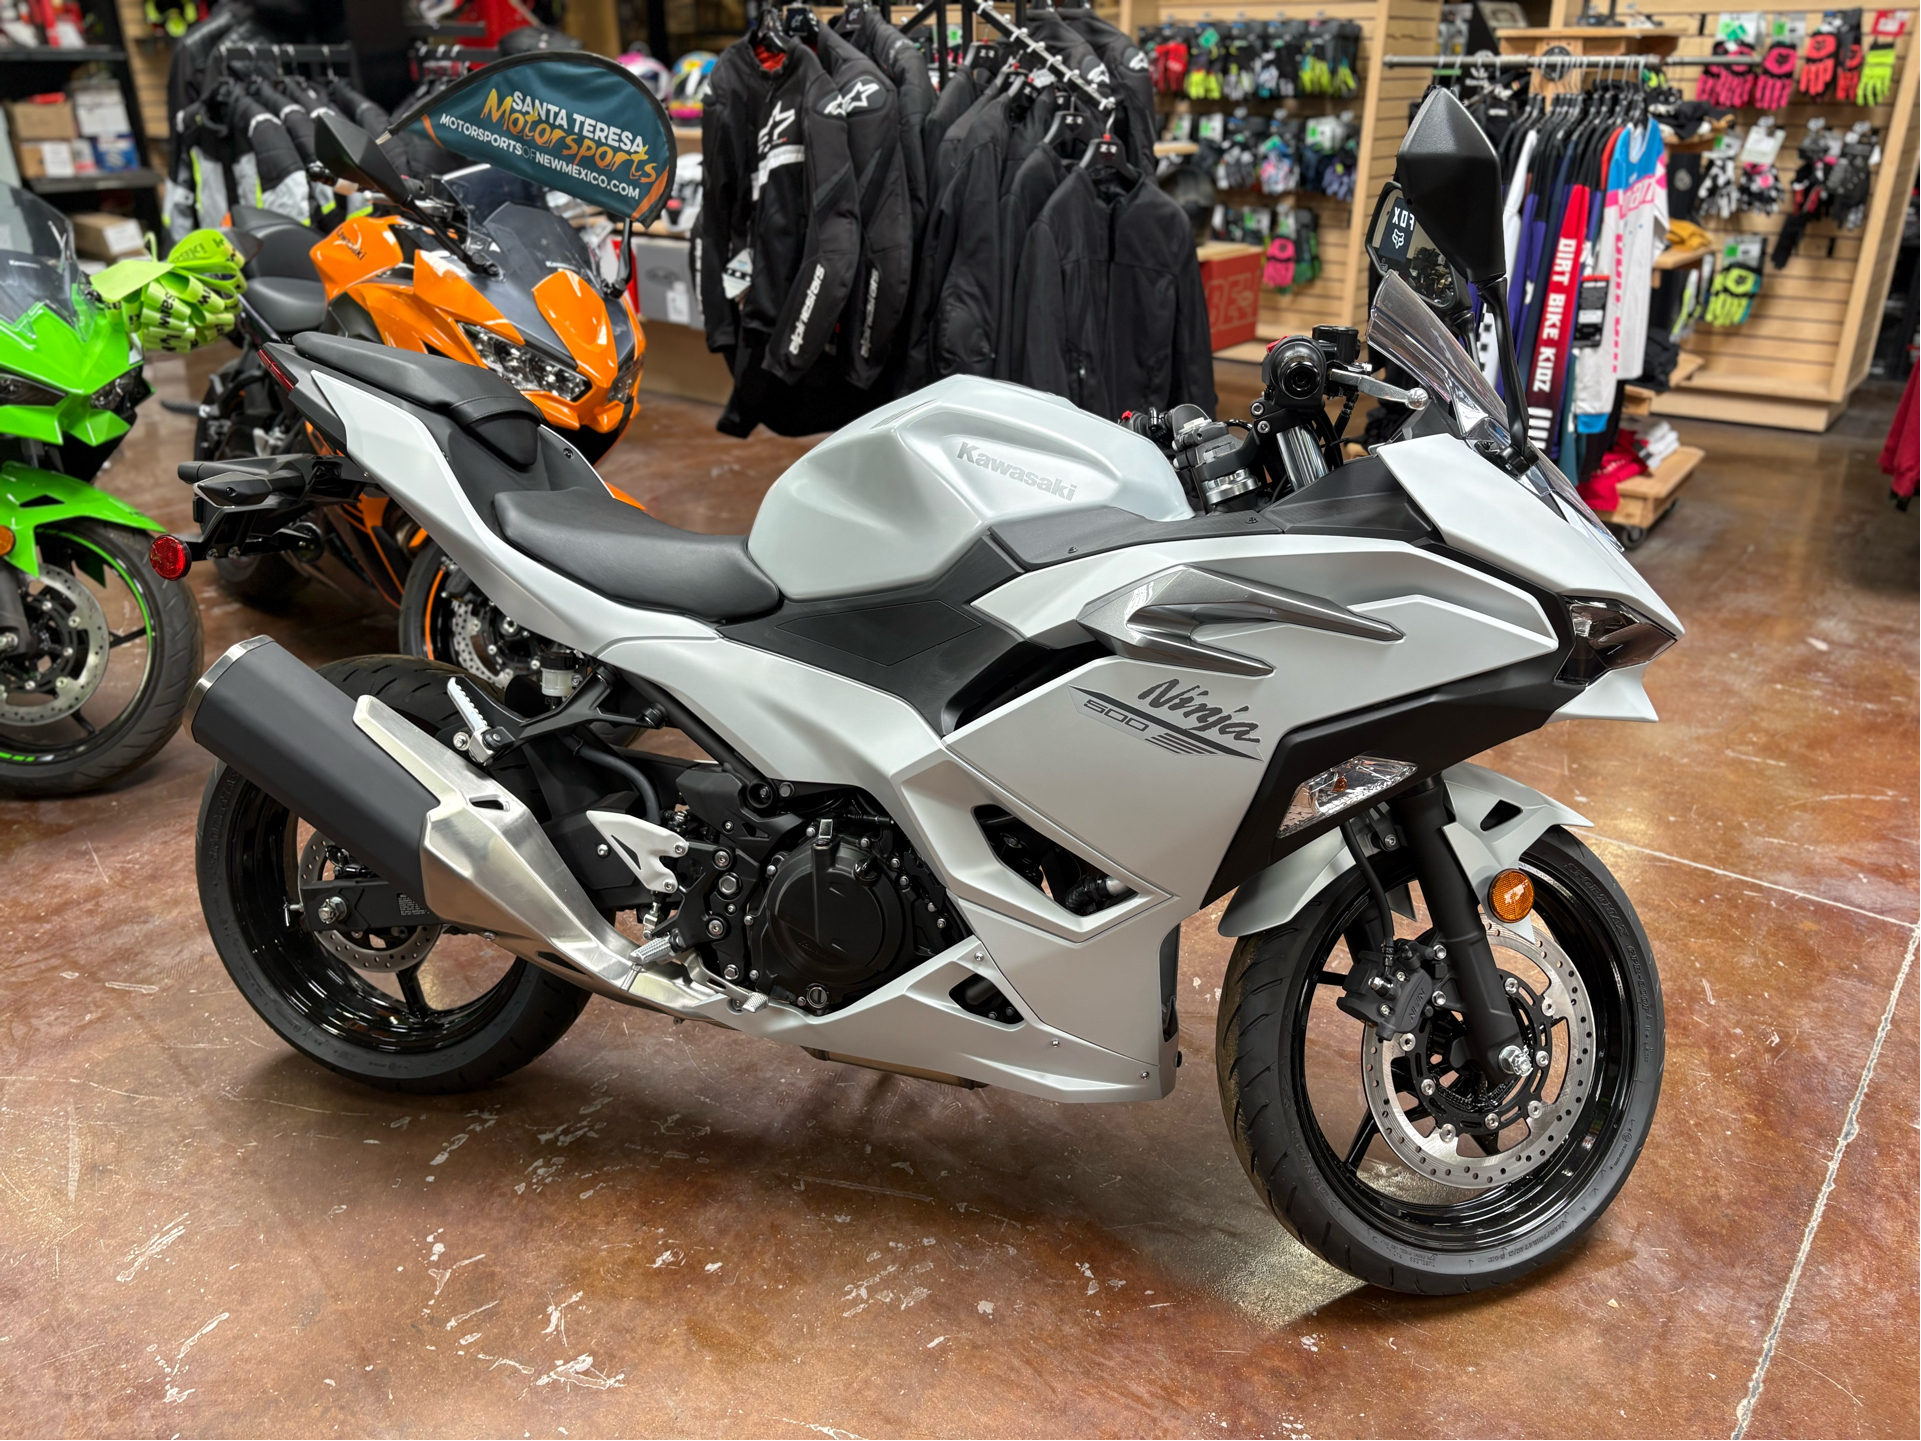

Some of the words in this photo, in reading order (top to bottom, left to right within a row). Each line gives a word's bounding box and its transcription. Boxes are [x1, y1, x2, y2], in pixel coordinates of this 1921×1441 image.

[480, 87, 658, 183] Motorsports
[512, 91, 568, 129] SANTA
[572, 114, 645, 153] TERESA
[1552, 237, 1577, 286] DIRT
[1542, 292, 1567, 341] BIKE
[1532, 345, 1557, 393] KIDZ
[957, 441, 1077, 501] Kawasaki
[1083, 698, 1150, 732] 500
[1137, 678, 1261, 743] Ninja
